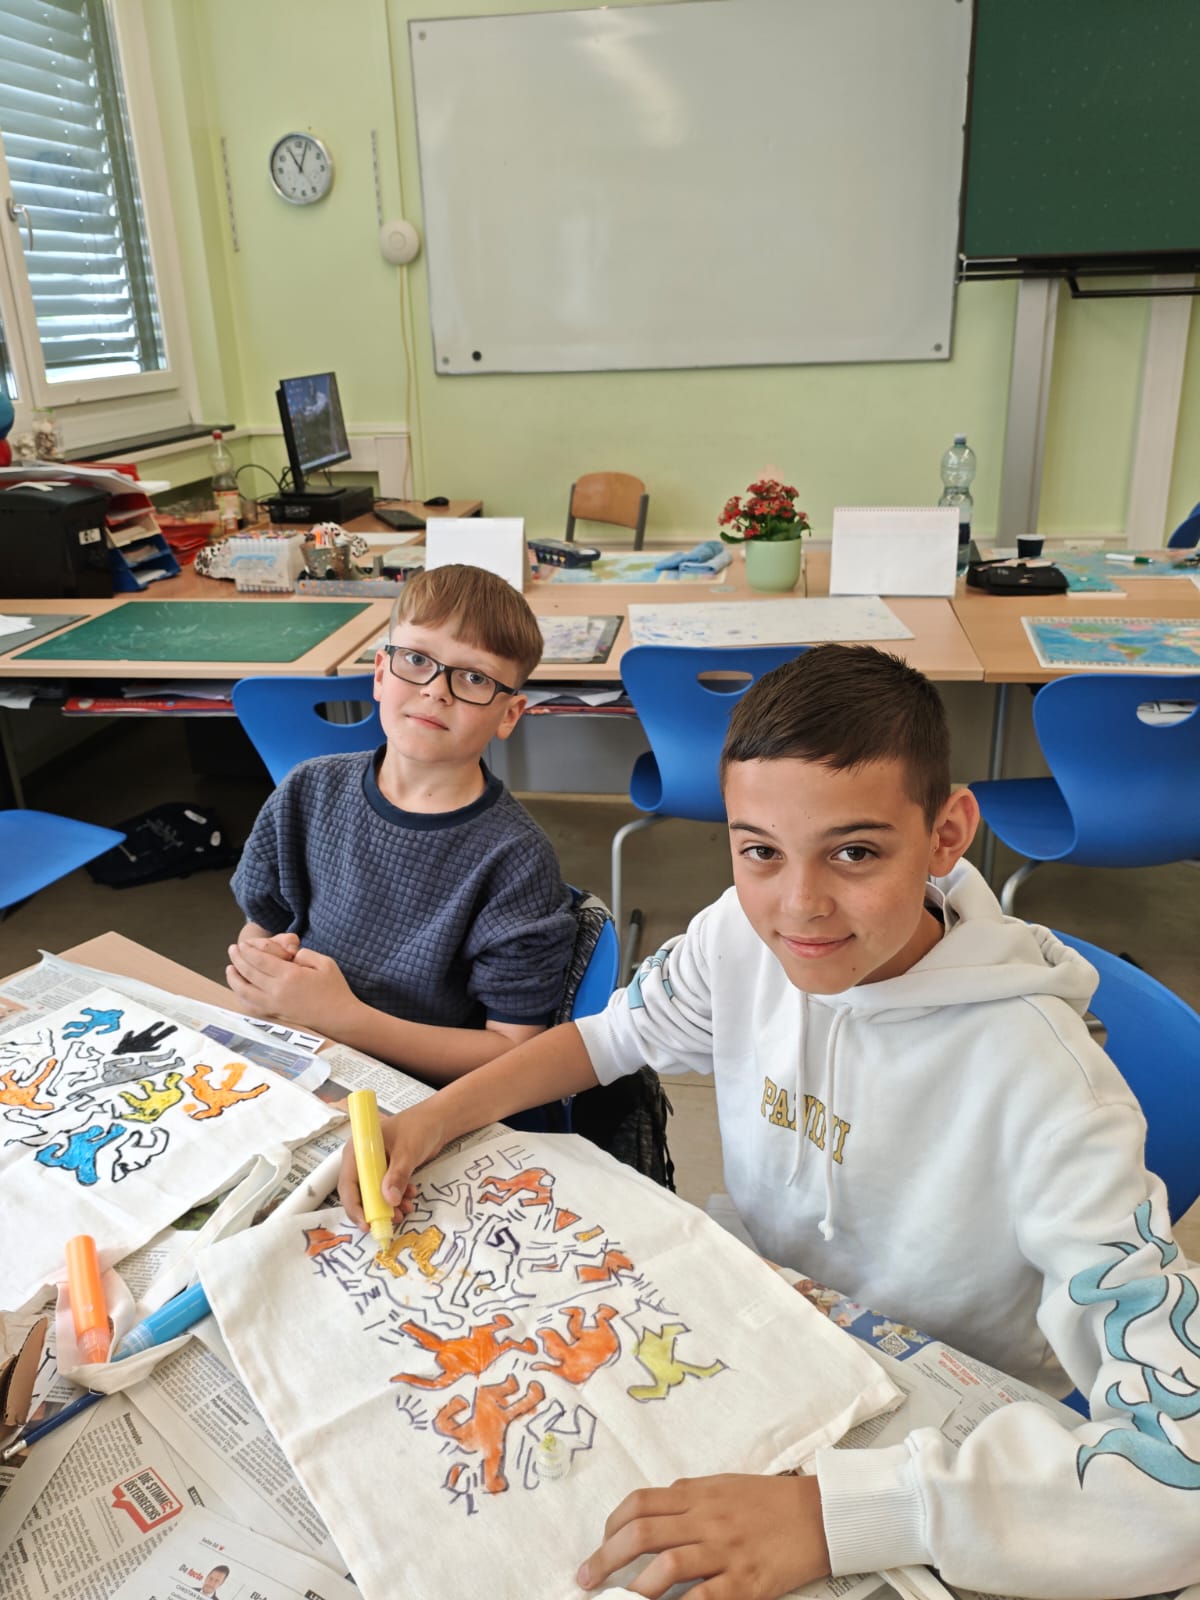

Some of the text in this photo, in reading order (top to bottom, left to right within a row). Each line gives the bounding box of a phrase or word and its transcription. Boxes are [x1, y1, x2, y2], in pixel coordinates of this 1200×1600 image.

[124, 1478, 162, 1521] ÖSTERREICHS
[137, 1472, 174, 1513] DIE STIMME
